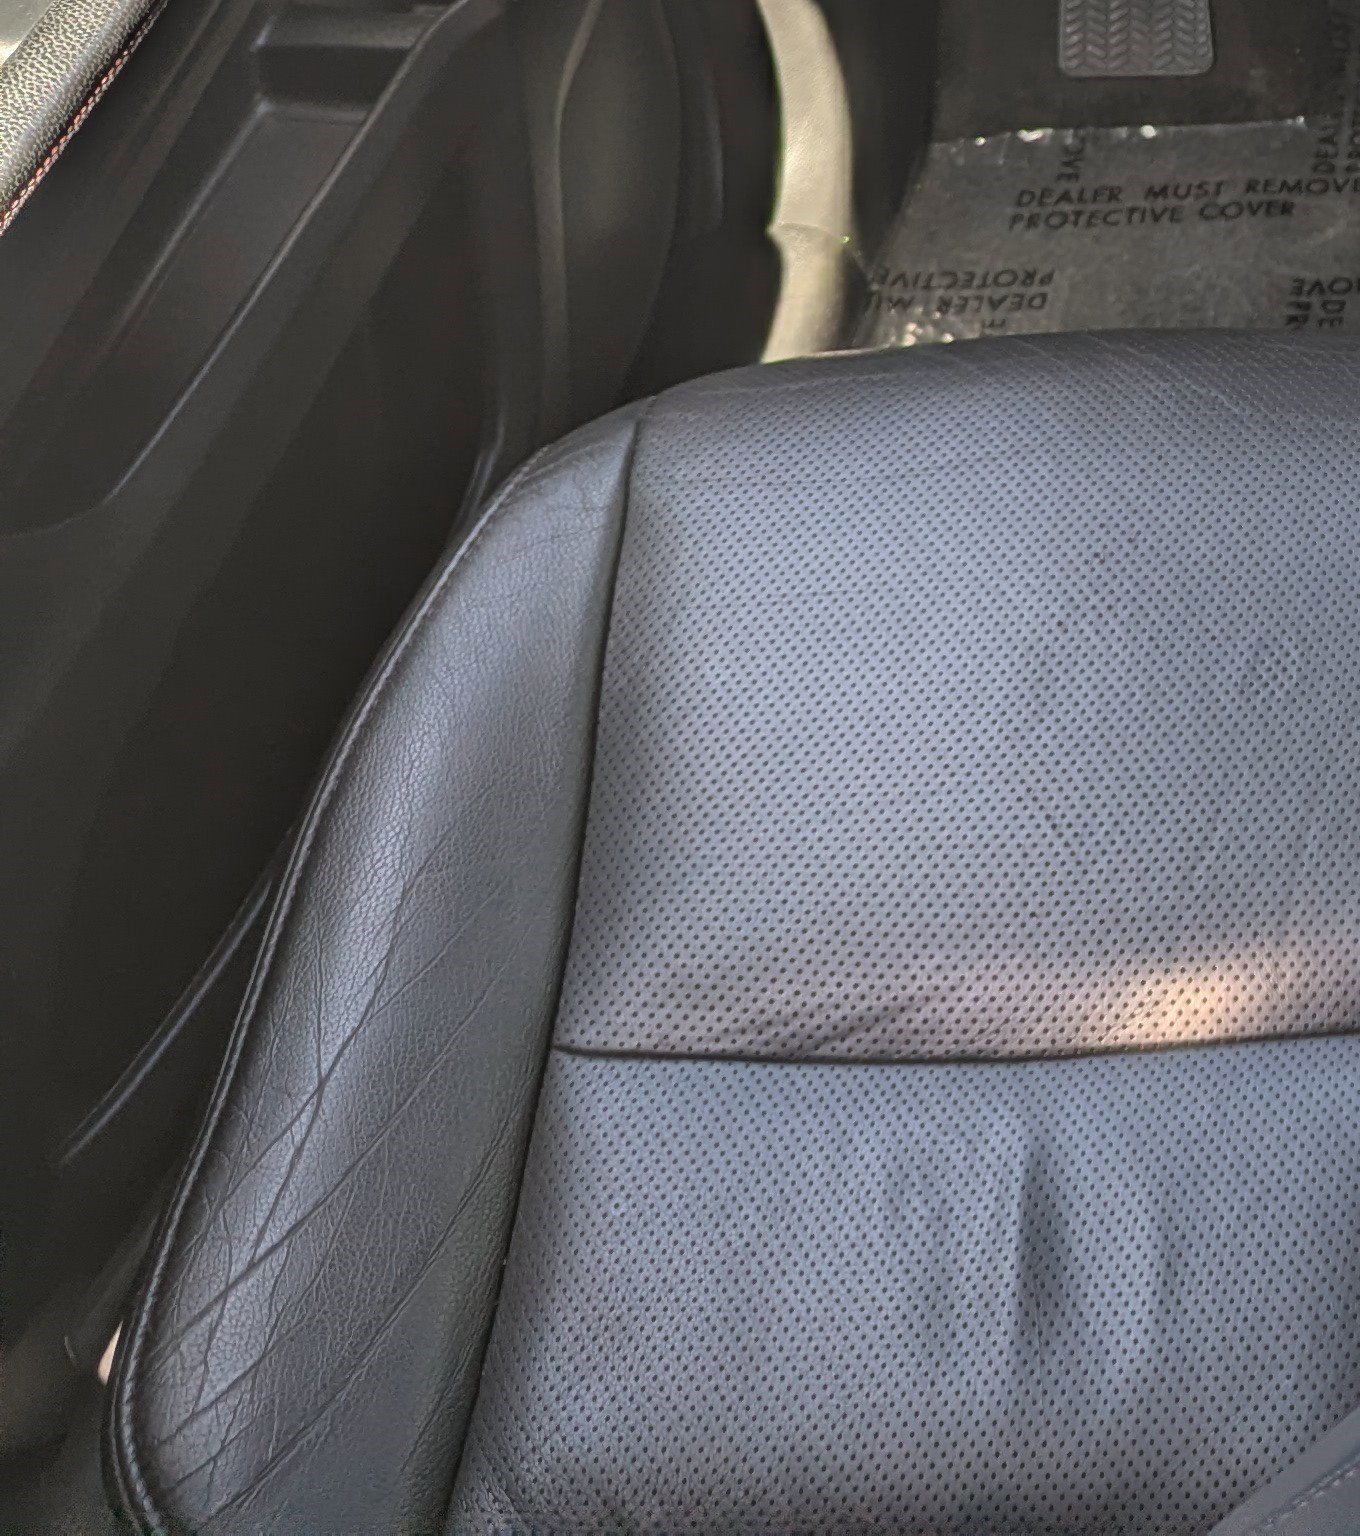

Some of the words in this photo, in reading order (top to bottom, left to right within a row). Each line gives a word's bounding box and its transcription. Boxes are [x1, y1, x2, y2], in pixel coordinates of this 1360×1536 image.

[1015, 184, 1122, 208] DEALER
[1143, 179, 1224, 202] MUST
[1008, 203, 1184, 232] PROTECTIVE
[1199, 199, 1295, 222] COVER
